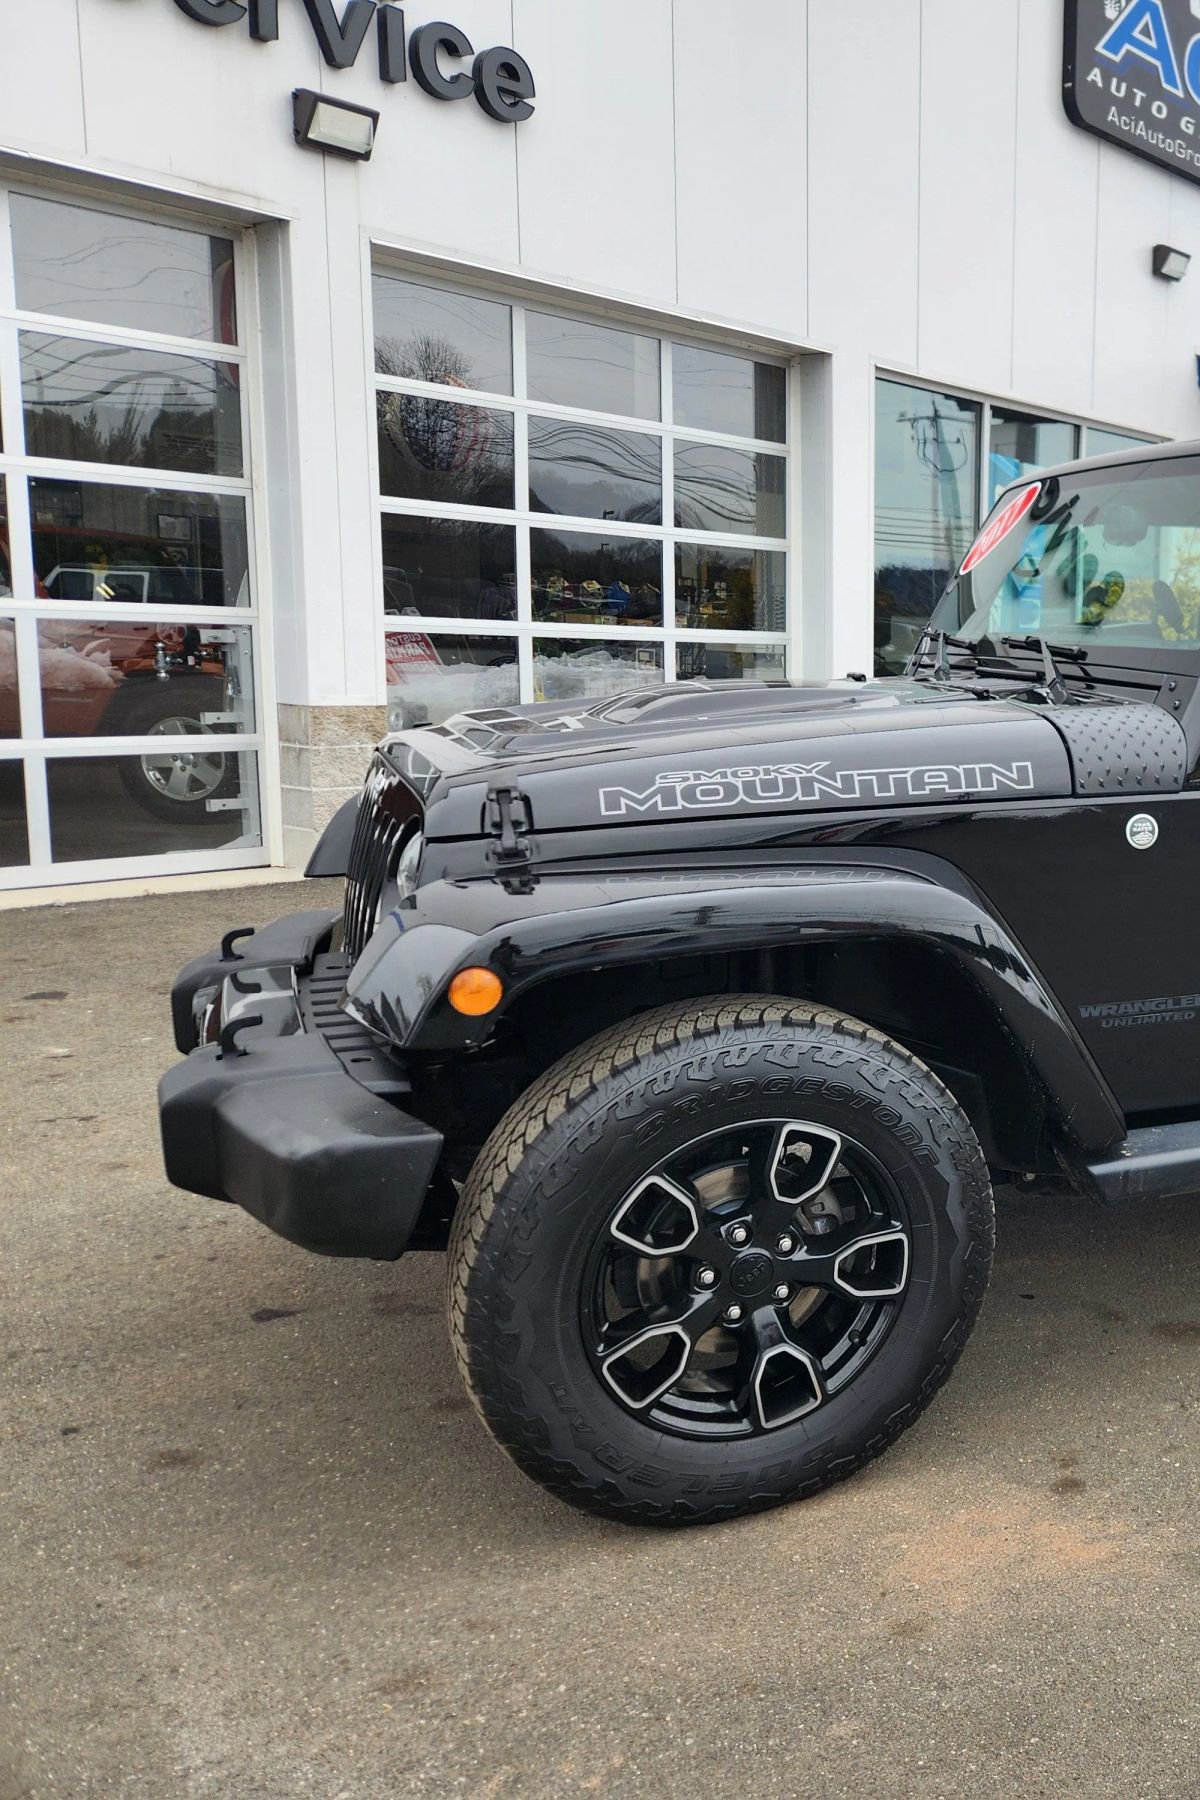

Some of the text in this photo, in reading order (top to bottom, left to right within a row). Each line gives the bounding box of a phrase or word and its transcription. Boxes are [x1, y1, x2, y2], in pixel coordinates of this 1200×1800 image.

[1086, 67, 1168, 119] AUTO
[599, 761, 1034, 816] MOUNTAIN
[655, 761, 831, 787] SMOKY
[1101, 1010, 1196, 1028] UNLIMITED
[633, 1074, 940, 1168] BRIDGESTONE
[737, 1262, 768, 1288] Jeep
